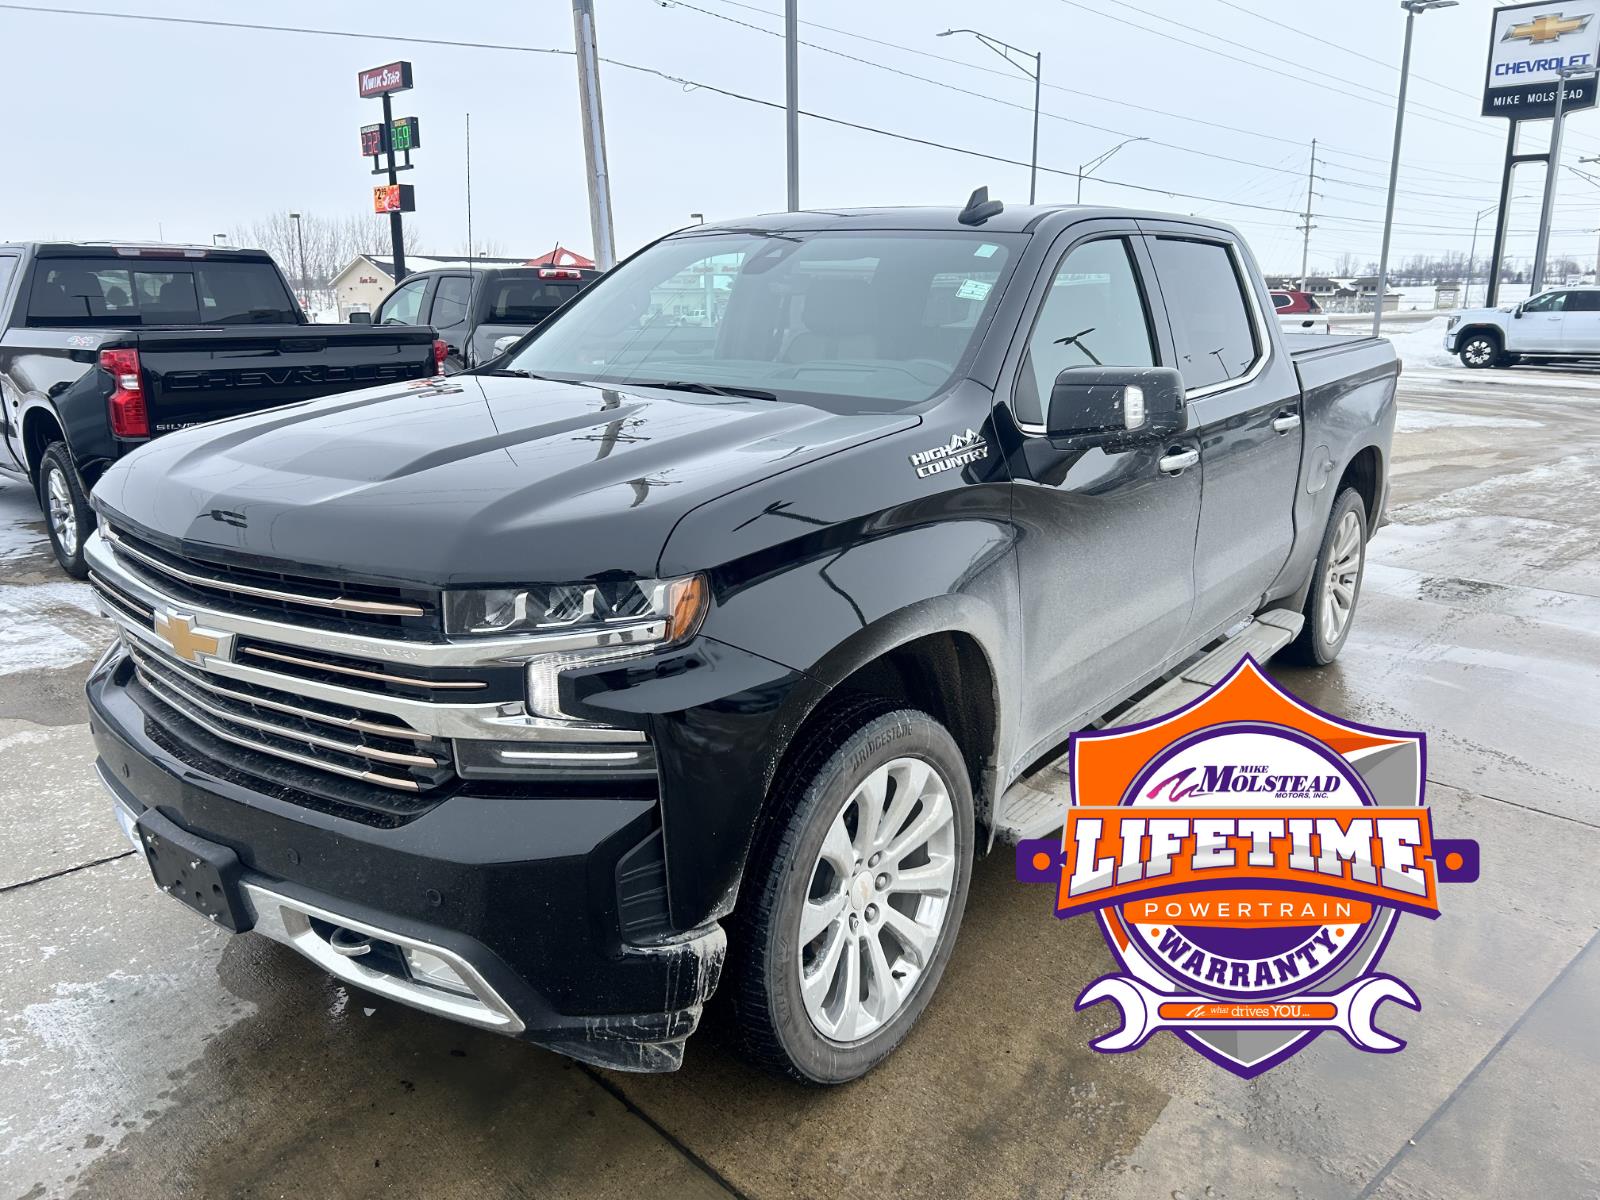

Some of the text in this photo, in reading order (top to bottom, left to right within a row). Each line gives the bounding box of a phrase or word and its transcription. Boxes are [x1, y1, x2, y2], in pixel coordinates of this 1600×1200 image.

[1495, 53, 1590, 76] CHEVROLET
[1493, 94, 1521, 106] MIKE
[169, 364, 421, 390] CHEVROLET
[910, 444, 952, 466] HIGH
[916, 446, 988, 478] COUNTRY
